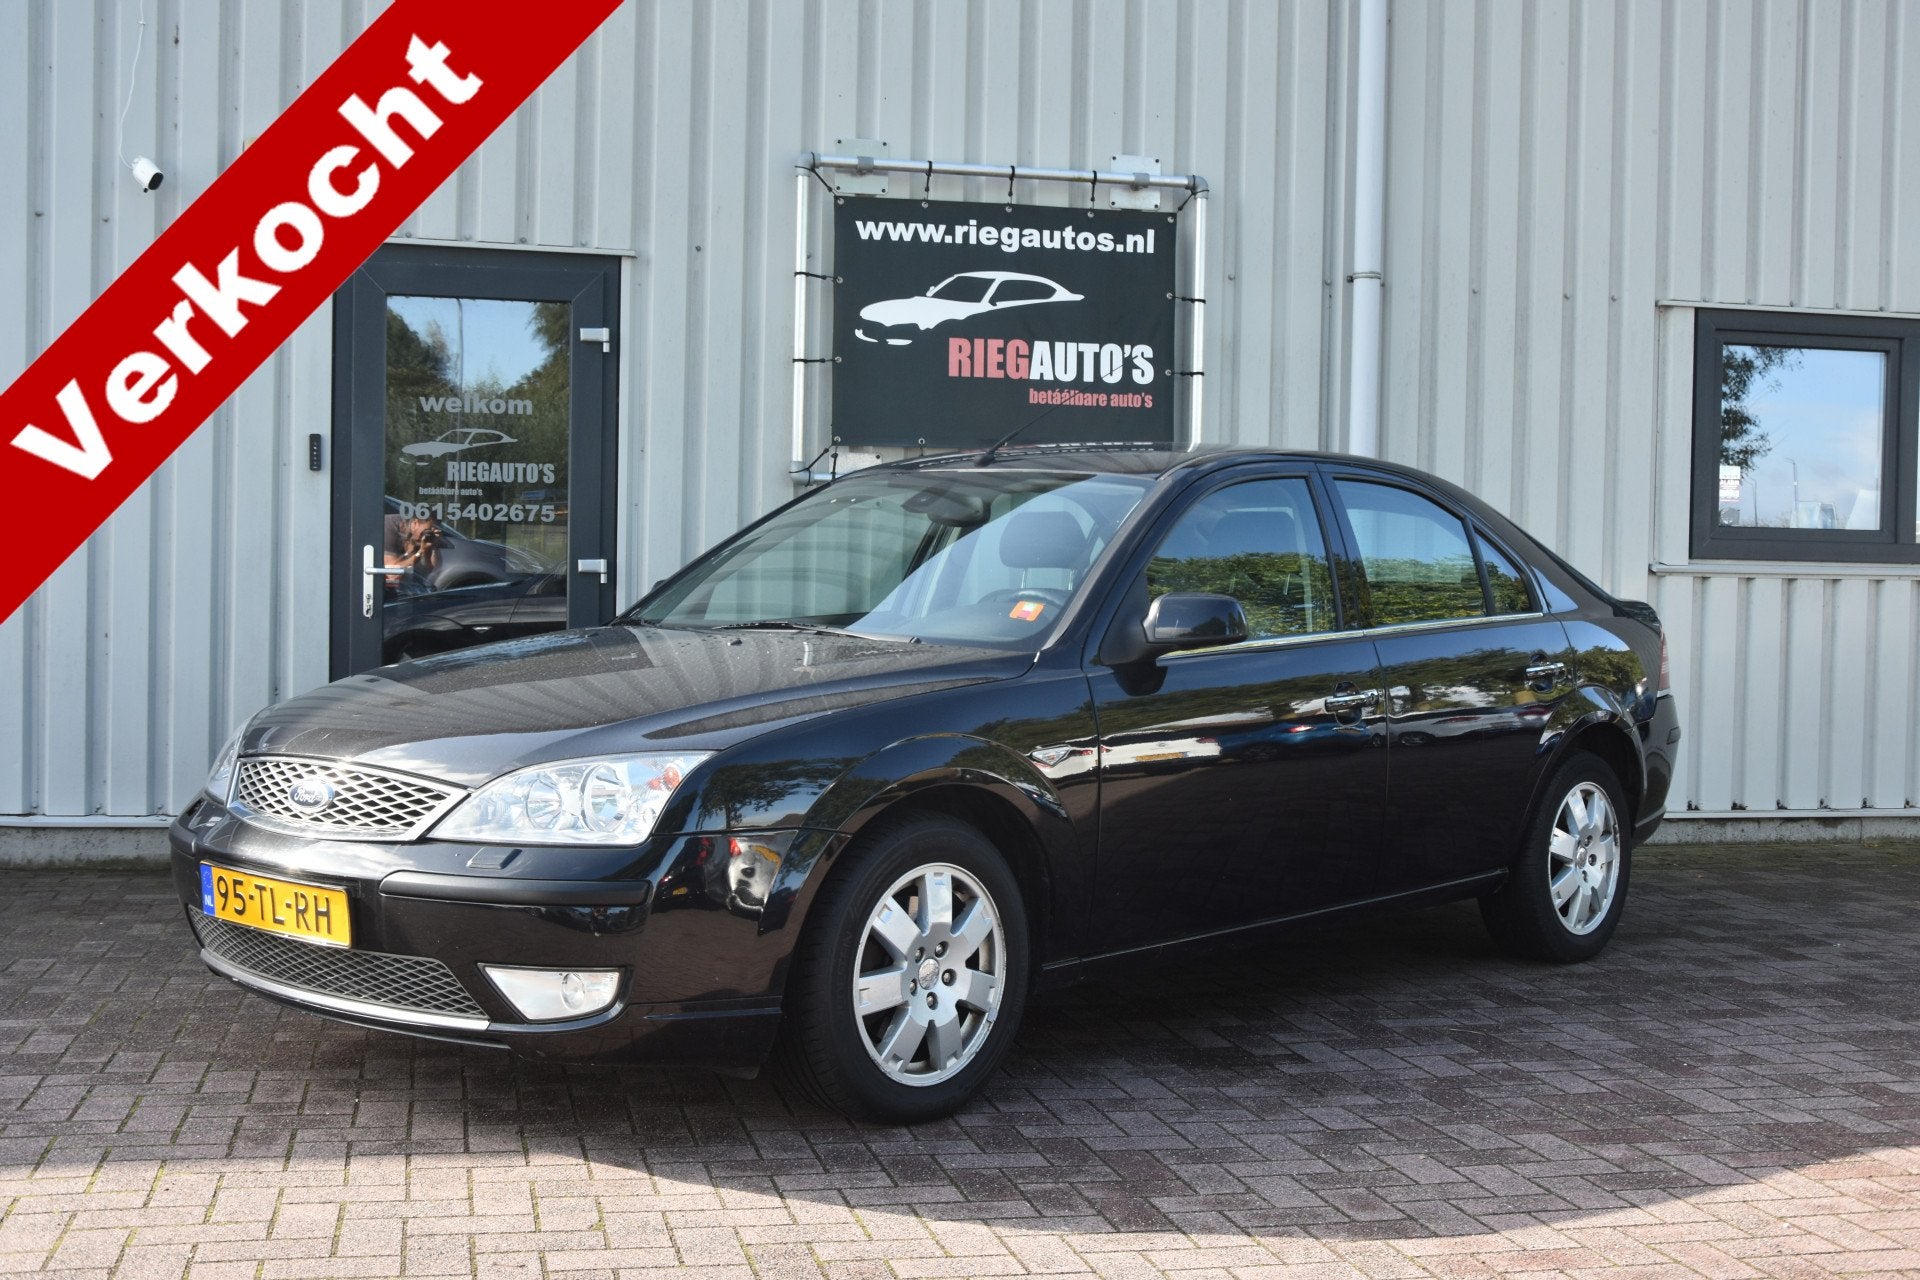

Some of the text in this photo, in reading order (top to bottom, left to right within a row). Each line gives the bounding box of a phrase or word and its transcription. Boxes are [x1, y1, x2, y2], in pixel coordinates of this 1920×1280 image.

[855, 219, 1155, 253] www.riegautos.nl
[948, 337, 1155, 384] RIEGAUTO'S
[419, 394, 533, 415] welkom
[1110, 394, 1153, 408] auto's
[447, 461, 555, 485] RIEGAUTO'S
[400, 502, 555, 522] 0615402675
[204, 894, 214, 907] NL
[216, 875, 333, 935] 95-TL-RH
